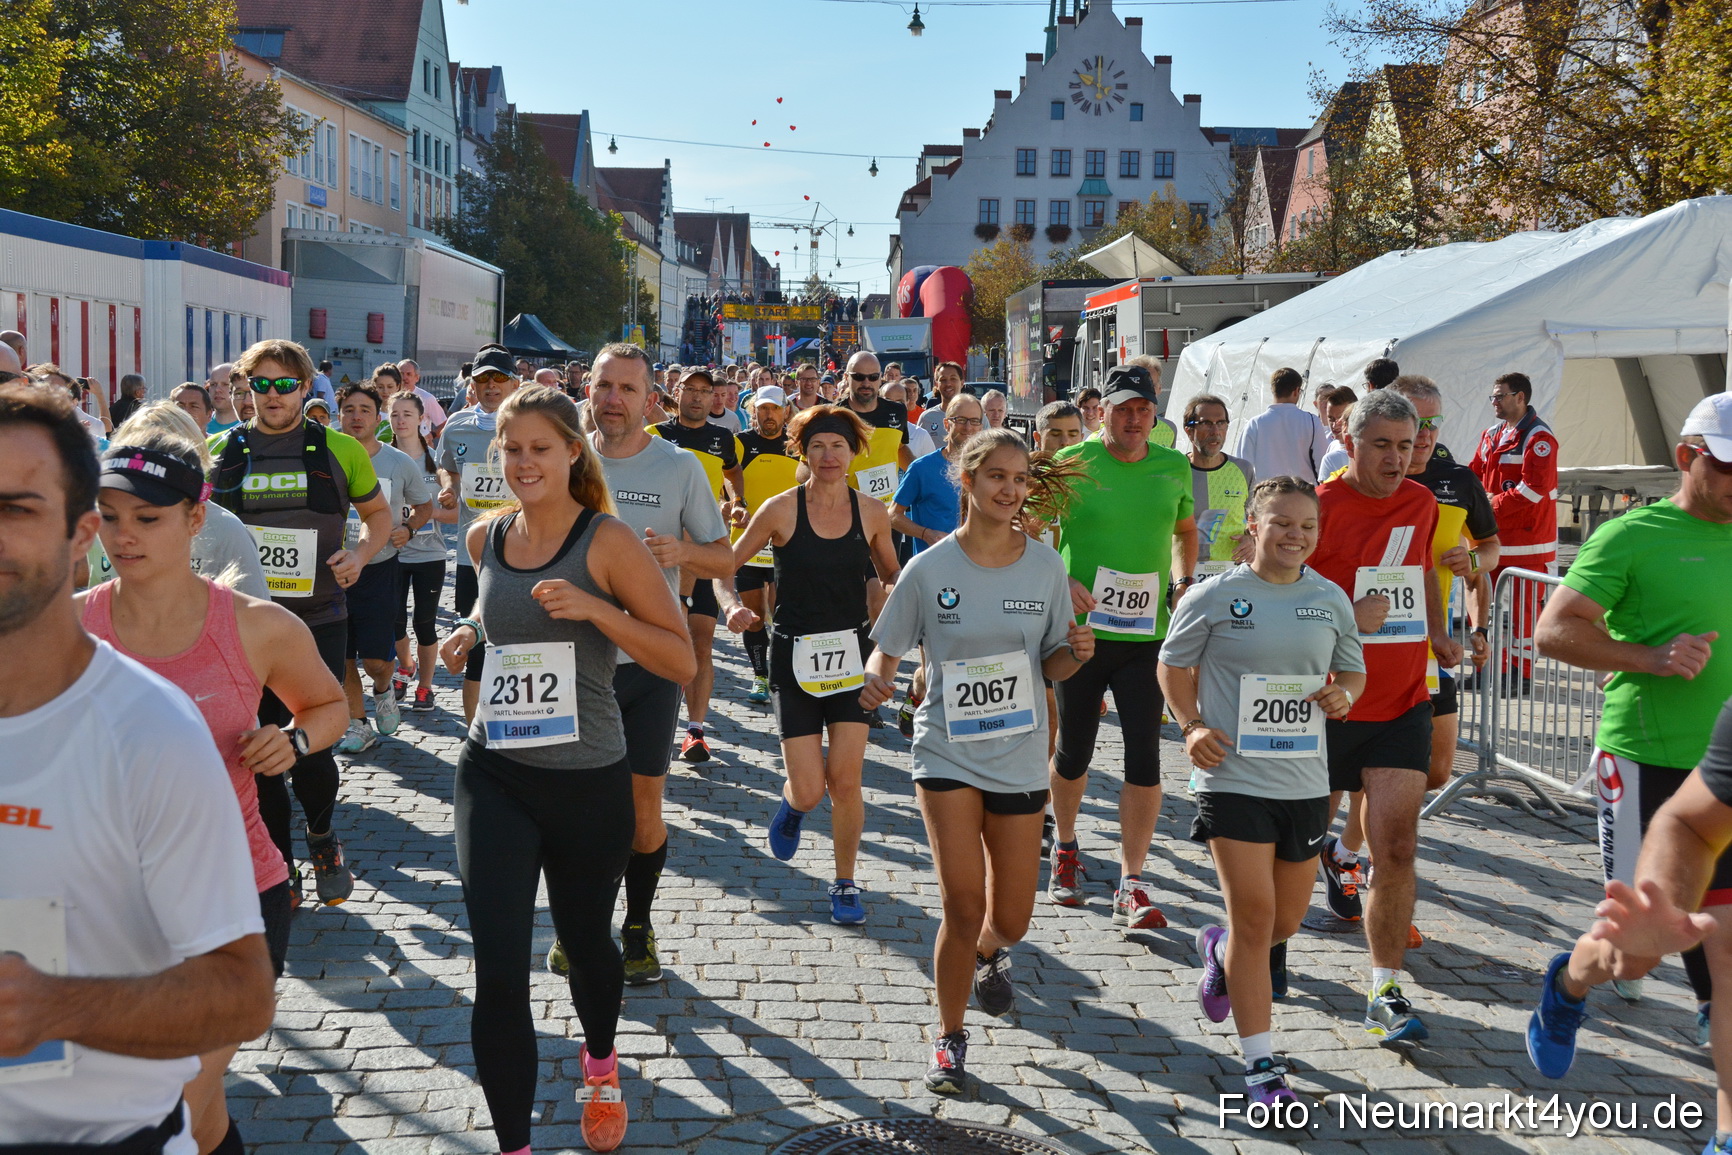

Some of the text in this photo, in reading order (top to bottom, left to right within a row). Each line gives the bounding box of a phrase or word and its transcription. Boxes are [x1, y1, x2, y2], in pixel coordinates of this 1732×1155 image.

[754, 307, 789, 317] START
[475, 476, 503, 493] 277
[869, 476, 890, 492] 231
[617, 490, 661, 504] BOCK
[263, 533, 297, 543] BOCK
[258, 546, 299, 568] 283
[1115, 577, 1144, 587] BOCK
[1376, 573, 1405, 582] BOCK
[1101, 587, 1150, 610] 2180
[1003, 600, 1045, 612] BOCK
[1295, 608, 1333, 621] BOCK
[1107, 617, 1136, 627] Helmut
[812, 638, 842, 648] BOCK
[502, 653, 542, 667] BOCK
[810, 650, 846, 672] 177
[967, 662, 1005, 676] BOCK
[489, 672, 559, 705] 2312
[820, 681, 843, 691] Birgit
[956, 676, 1018, 708] 2067
[1266, 682, 1303, 693] BOCK
[964, 705, 1009, 717] PARTL Neumarkt
[1252, 698, 1312, 724] 2069
[504, 723, 540, 737] Laura
[979, 718, 1005, 731] Rosa
[1270, 738, 1294, 750] Lena
